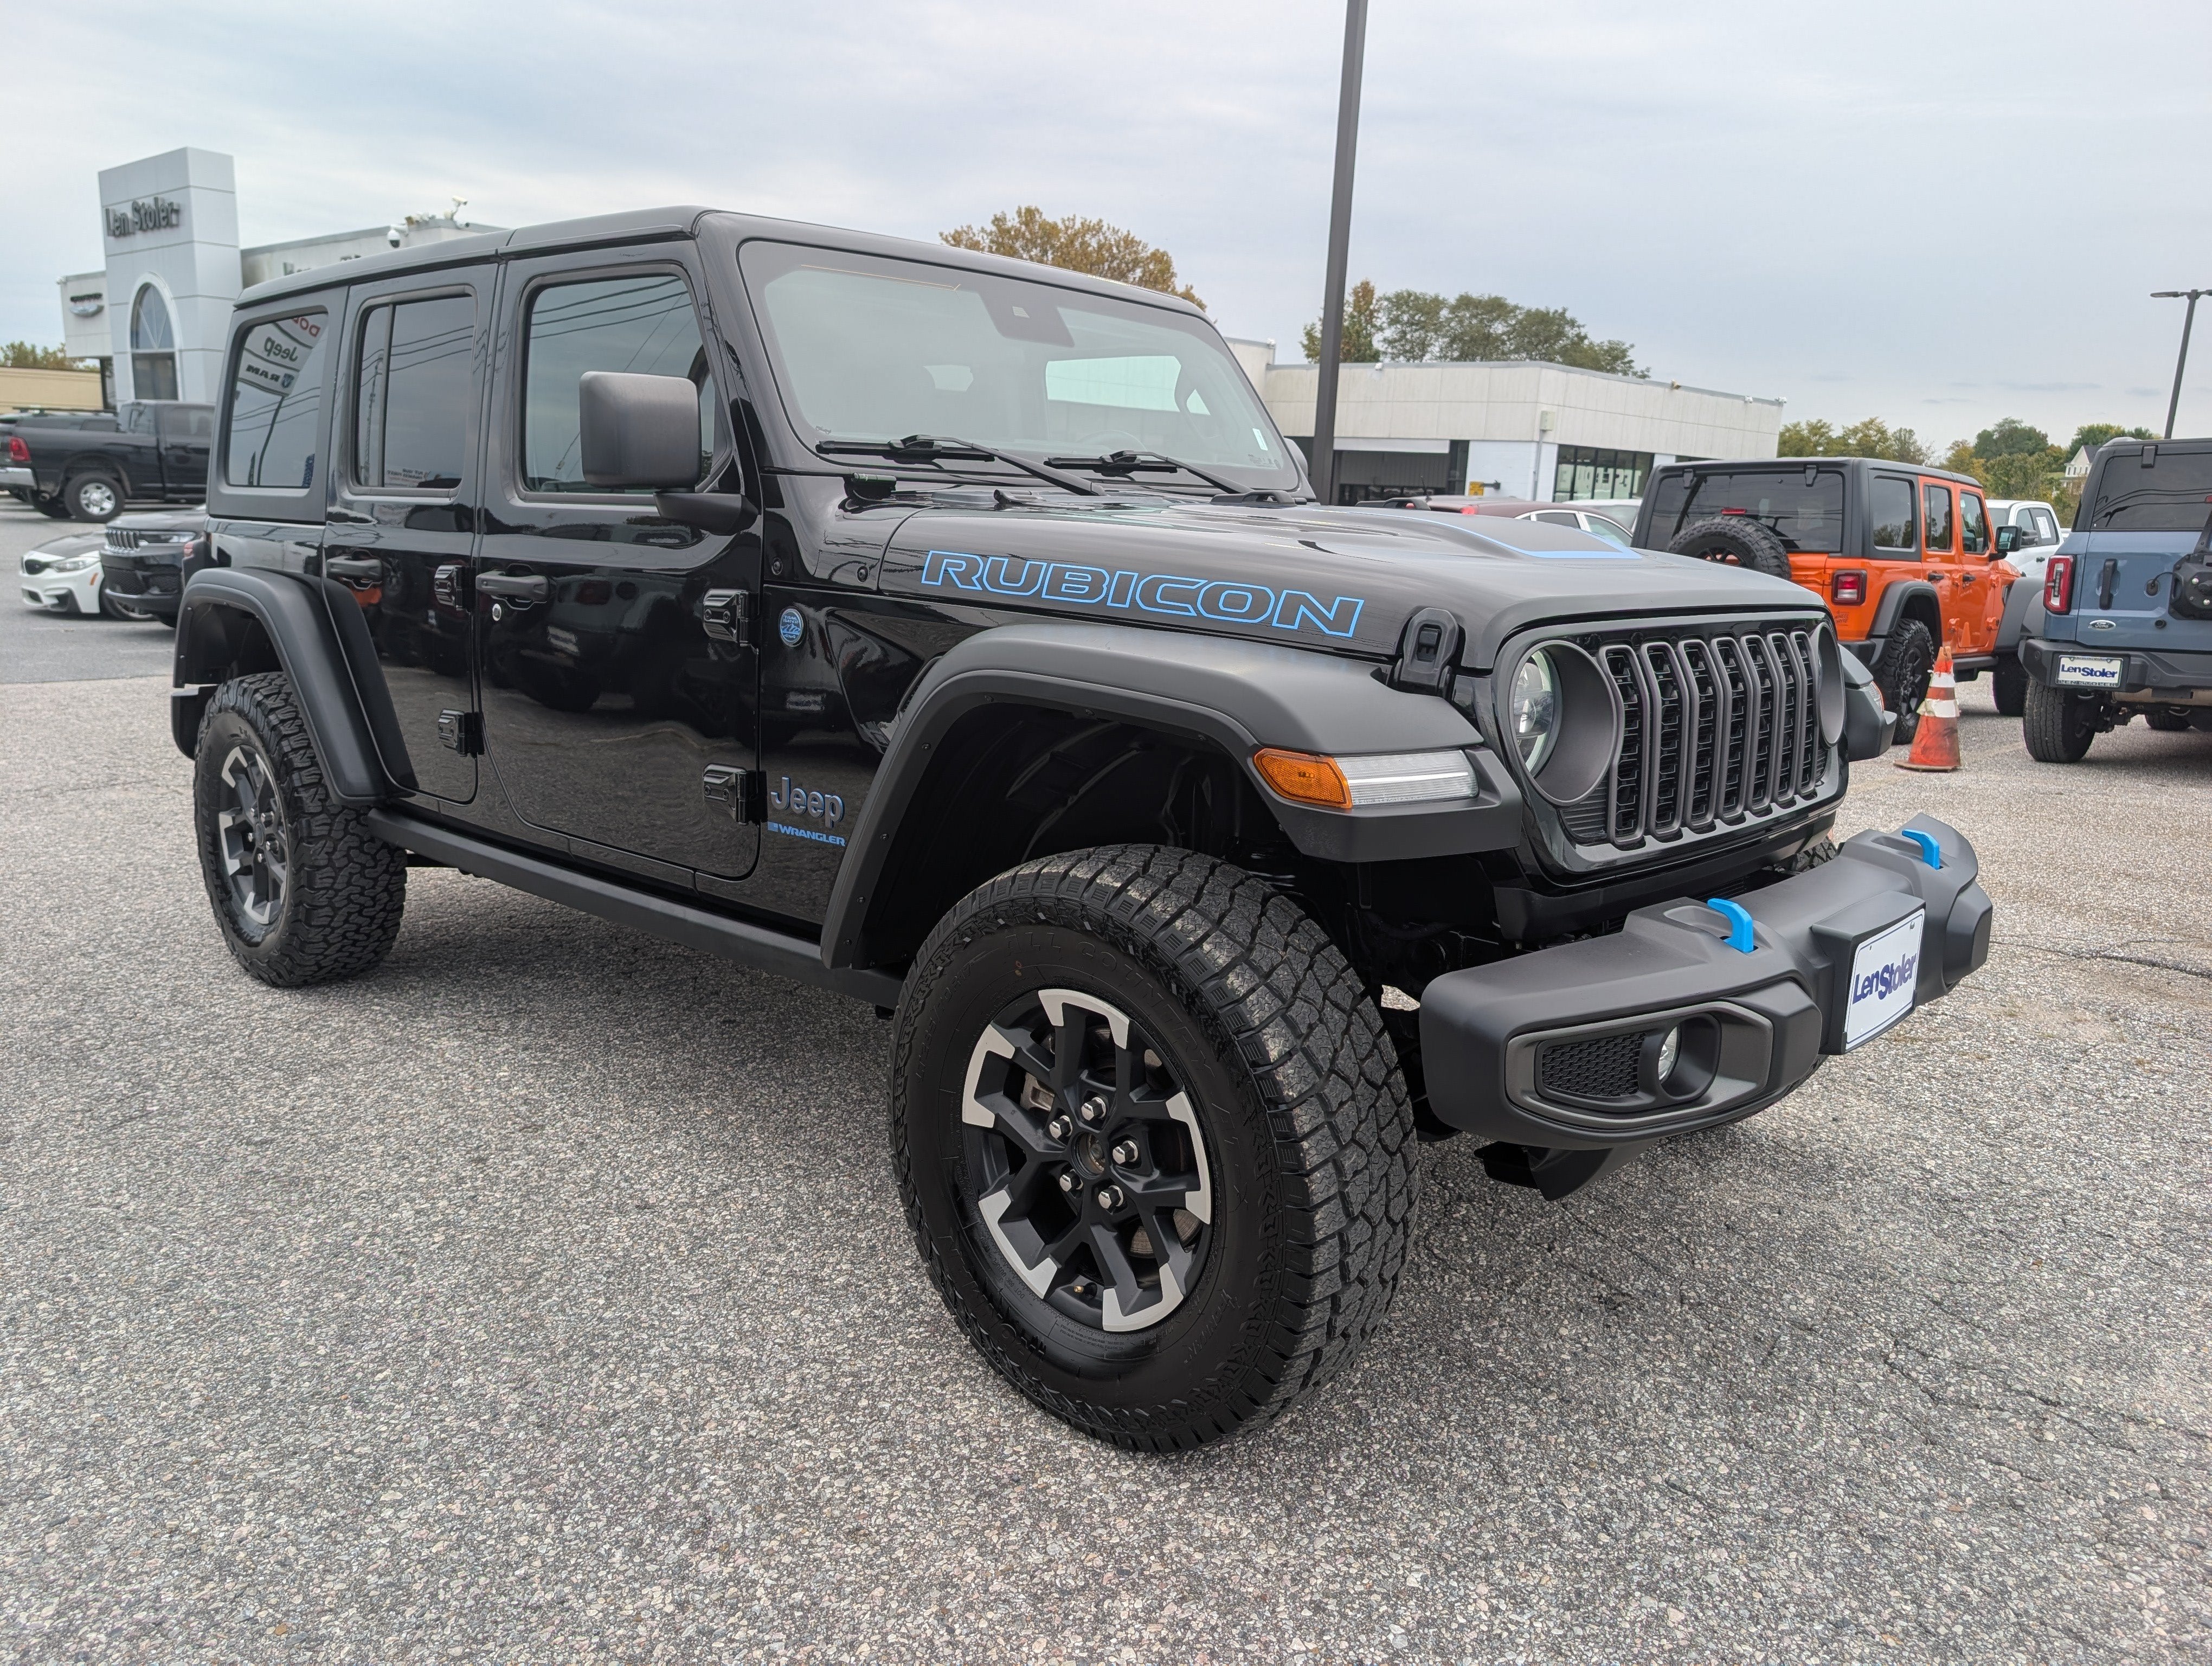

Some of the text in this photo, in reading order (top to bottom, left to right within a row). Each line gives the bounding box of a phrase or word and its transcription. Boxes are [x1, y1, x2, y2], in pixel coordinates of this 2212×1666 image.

[106, 196, 181, 238] Len Stoler
[922, 550, 1365, 638] RUBICON
[770, 777, 845, 828] Jeep
[778, 824, 846, 847] WRANGLER
[1000, 929, 1062, 961] ALL
[1076, 938, 1218, 1084] COUNTRY
[1014, 1285, 1025, 1300] DOT
